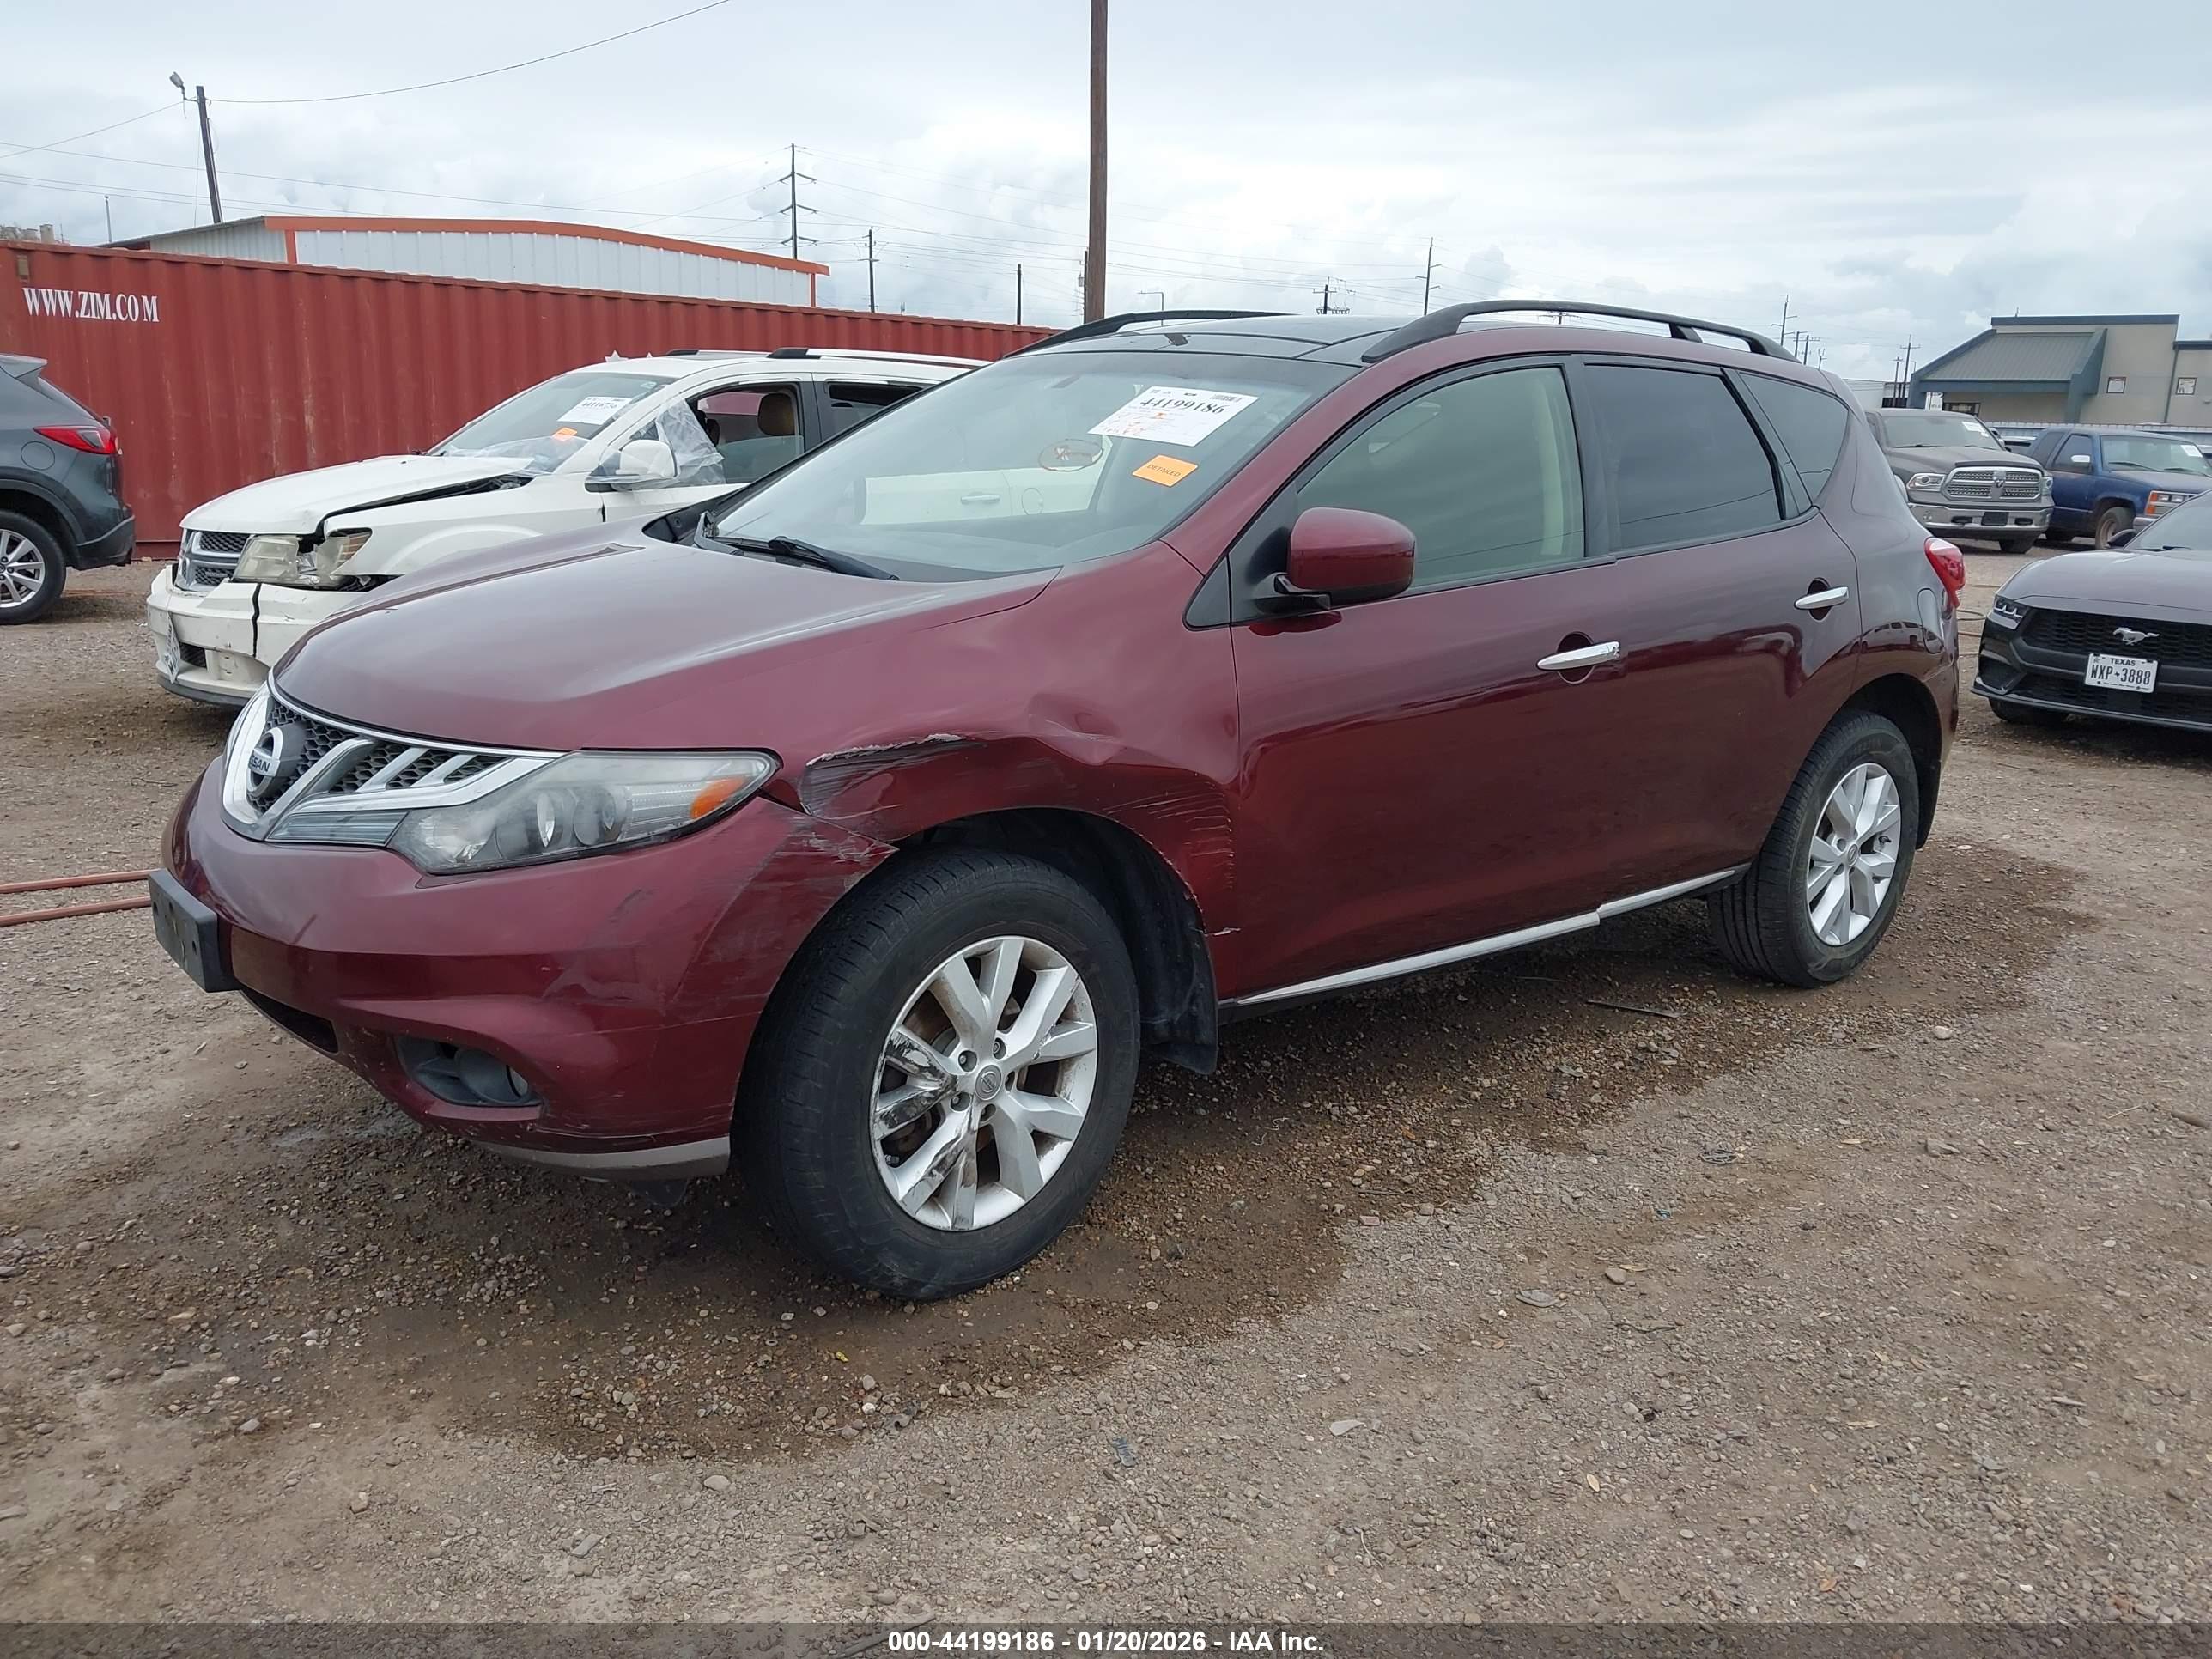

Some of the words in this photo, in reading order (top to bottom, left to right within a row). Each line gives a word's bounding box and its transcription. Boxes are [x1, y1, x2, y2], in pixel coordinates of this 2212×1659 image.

[22, 287, 160, 322] WWW.ZIM.COM
[1140, 397, 1228, 414] 44199186
[1146, 464, 1182, 477] DETAILED
[2111, 658, 2136, 666] TEXAS
